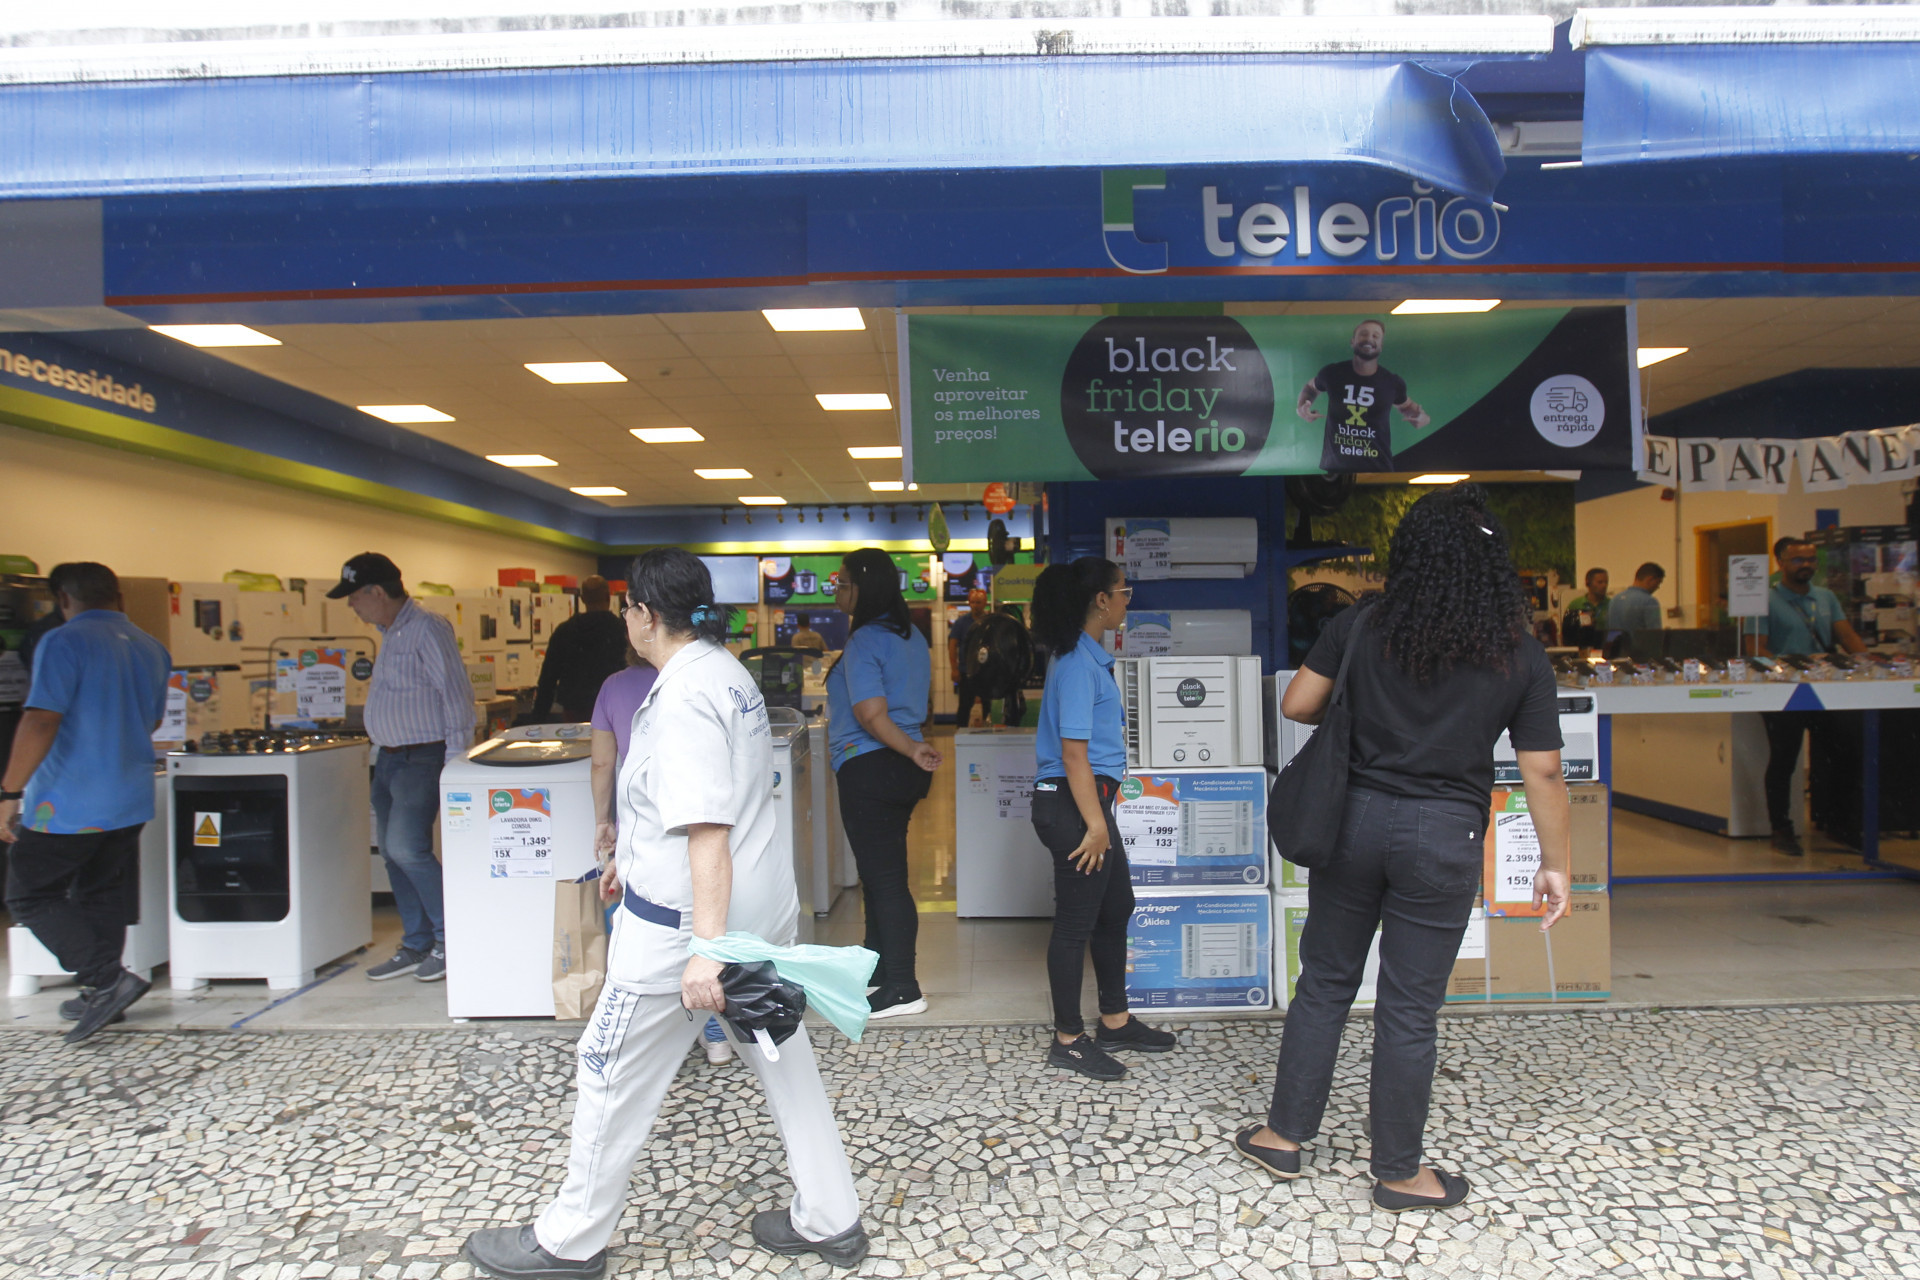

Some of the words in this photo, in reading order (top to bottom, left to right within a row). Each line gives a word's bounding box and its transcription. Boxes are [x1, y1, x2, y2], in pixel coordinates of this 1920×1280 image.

[1202, 181, 1501, 260] telerio
[1104, 336, 1237, 373] black
[0, 348, 157, 413] necessidade
[932, 367, 990, 382] Venha
[934, 386, 1028, 405] aproveitar
[1086, 378, 1224, 420] friday
[1343, 384, 1375, 407] 15
[934, 410, 954, 421] os
[958, 406, 1041, 420] melhores
[1345, 405, 1368, 427] X
[1543, 414, 1588, 424] entrega
[934, 425, 997, 443] preços!
[1338, 424, 1376, 438] black
[1557, 422, 1595, 433] rápida
[1114, 420, 1246, 453] telerio
[1334, 433, 1372, 448] friday
[1340, 444, 1378, 458] telerio
[1148, 826, 1174, 834] 1.999
[521, 837, 546, 846] 1.349
[1155, 838, 1172, 847] 133
[494, 850, 511, 858] 15X
[535, 849, 547, 858] 89
[1505, 854, 1542, 864] 2.399,9
[1507, 876, 1534, 887] 159,
[1133, 904, 1181, 914] pringer
[1140, 916, 1170, 926] Midea
